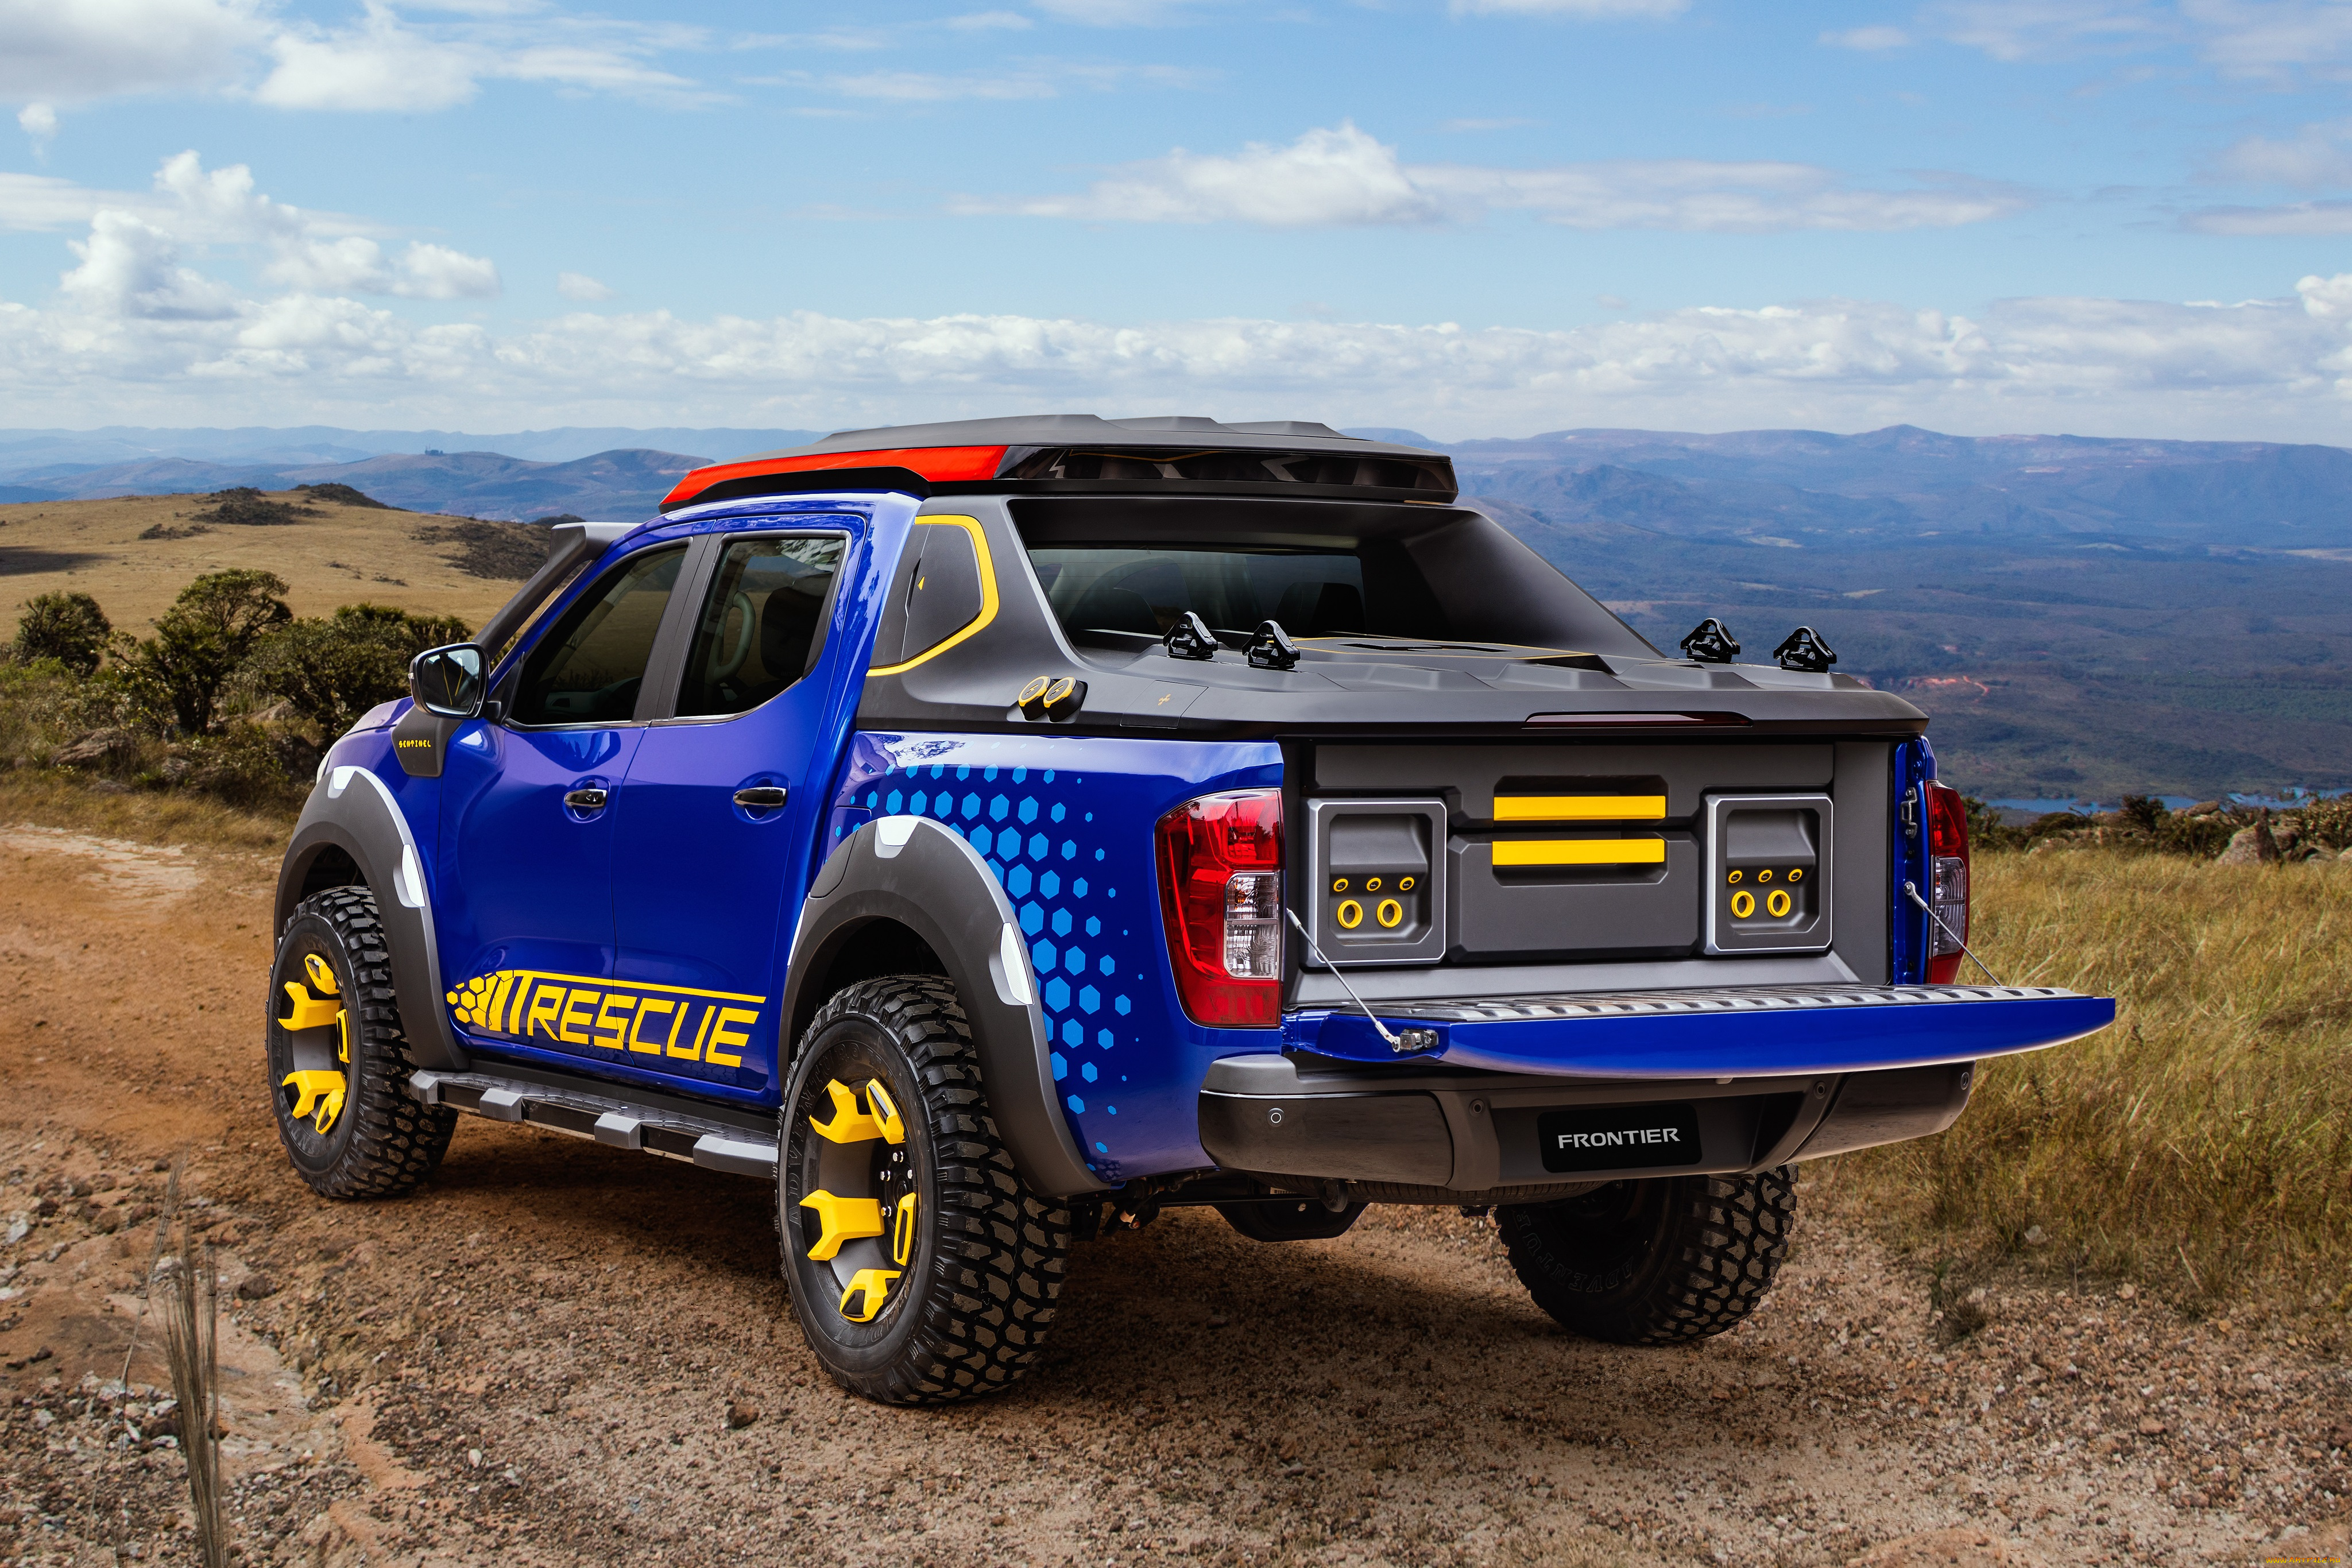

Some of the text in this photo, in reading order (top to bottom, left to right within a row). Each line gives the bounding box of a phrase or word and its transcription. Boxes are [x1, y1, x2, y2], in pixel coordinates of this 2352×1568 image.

[398, 740, 431, 748] SENTINEL
[1558, 1128, 1680, 1149] FRONTIER
[1511, 1208, 1635, 1294] ADVENTUR
